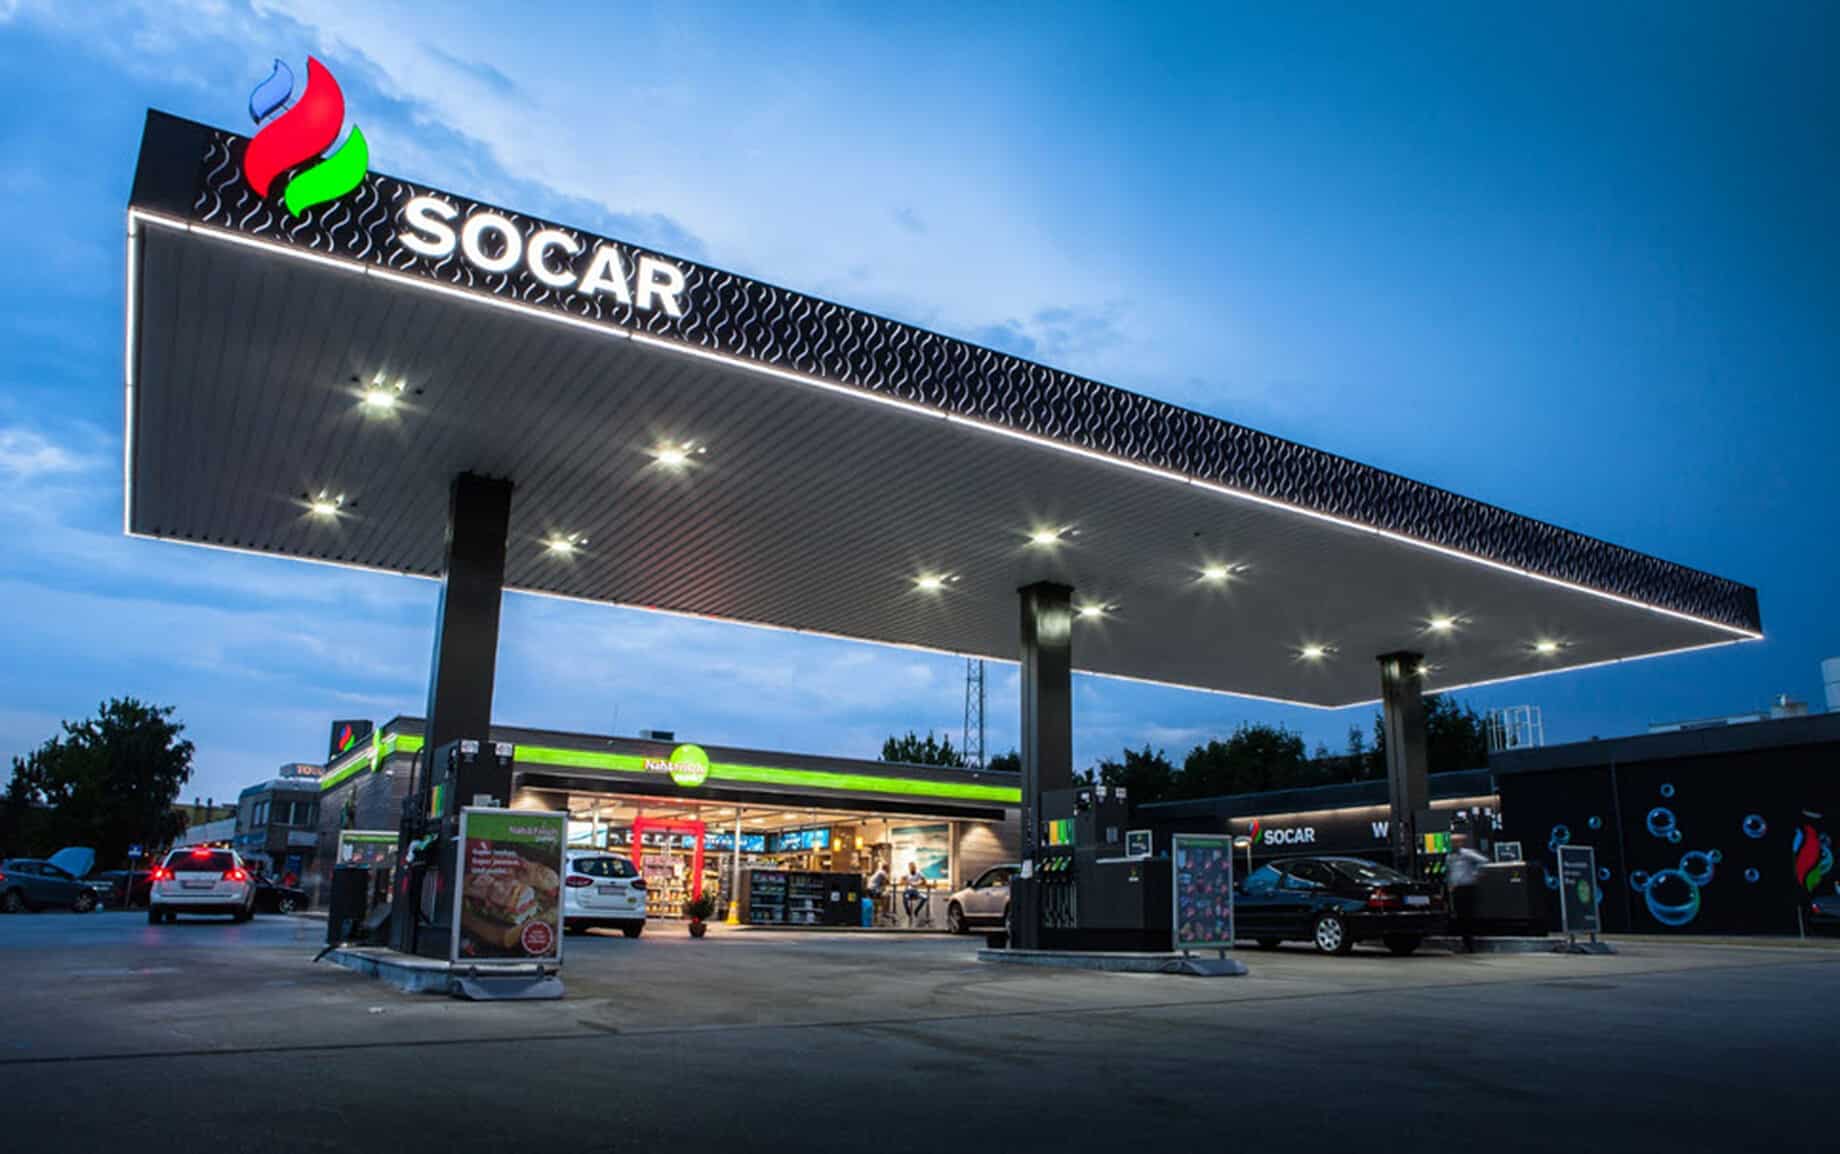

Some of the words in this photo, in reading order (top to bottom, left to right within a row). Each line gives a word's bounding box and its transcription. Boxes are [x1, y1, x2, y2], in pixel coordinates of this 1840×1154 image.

[398, 195, 686, 318] SOCAR
[1264, 827, 1316, 845] SOCAR
[1371, 821, 1390, 838] W
